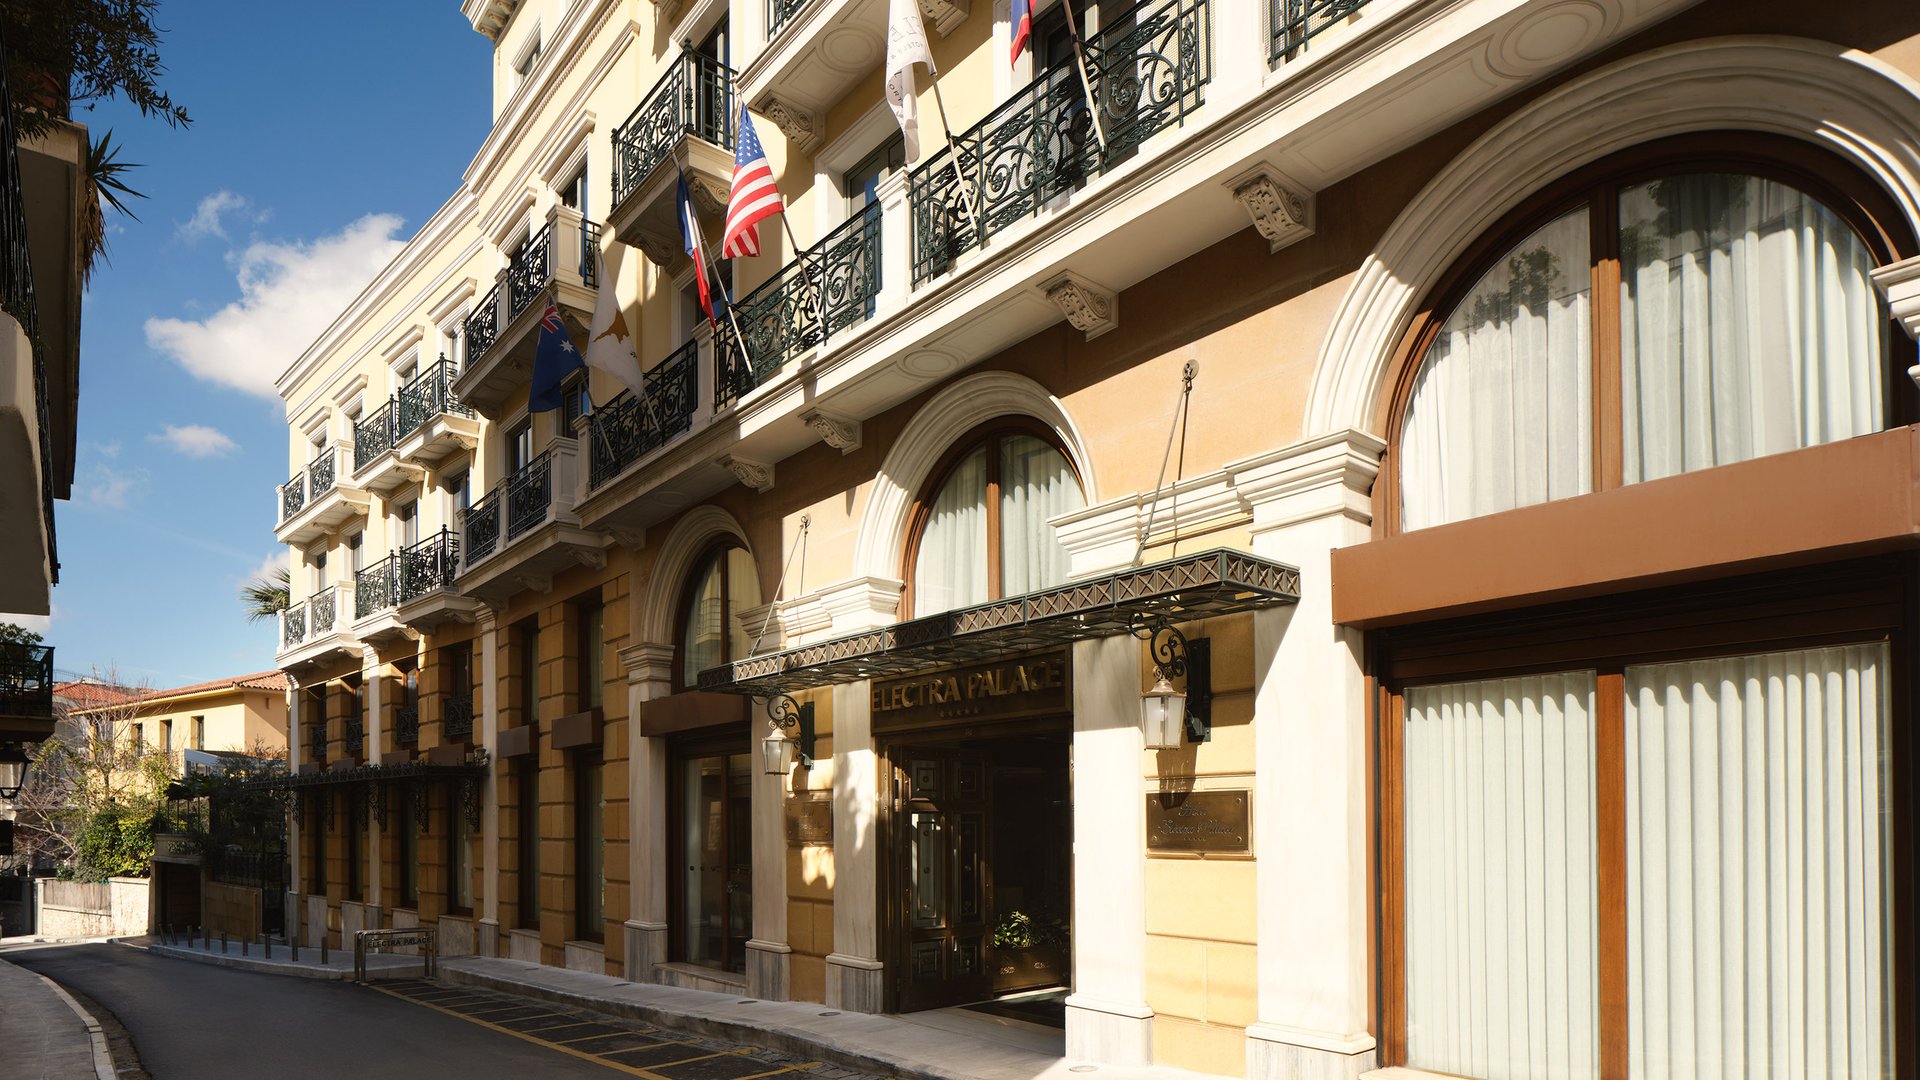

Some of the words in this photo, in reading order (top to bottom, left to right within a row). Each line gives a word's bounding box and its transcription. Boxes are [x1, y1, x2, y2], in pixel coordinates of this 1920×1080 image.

[871, 676, 962, 712] ELECTRA
[968, 659, 1063, 700] PALACE
[367, 938, 401, 949] ELECTRA
[404, 935, 433, 946] PALACE
